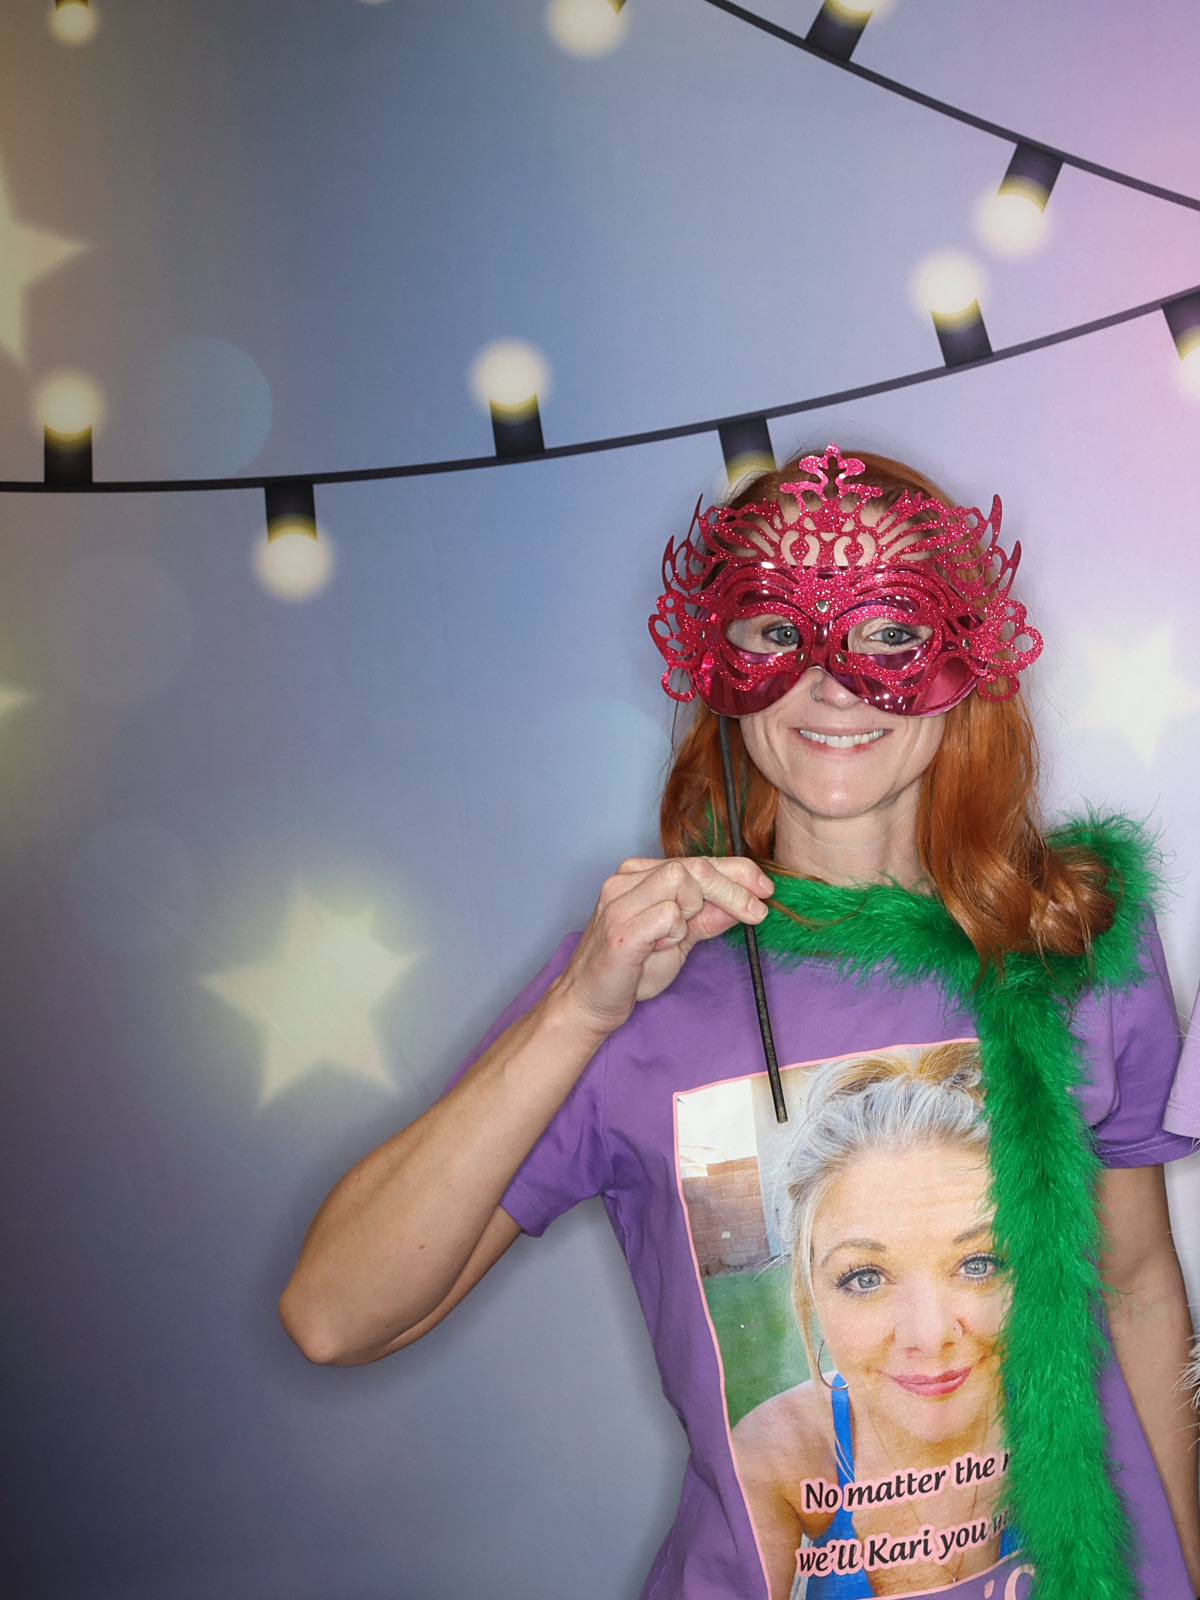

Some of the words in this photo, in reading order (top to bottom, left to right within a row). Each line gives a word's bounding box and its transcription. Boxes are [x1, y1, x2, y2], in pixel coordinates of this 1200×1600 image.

[804, 1482, 838, 1509] No
[846, 1469, 946, 1507] matter
[955, 1457, 995, 1485] the
[799, 1543, 859, 1572] we'll
[868, 1530, 931, 1566] Kari
[939, 1522, 987, 1559] you
